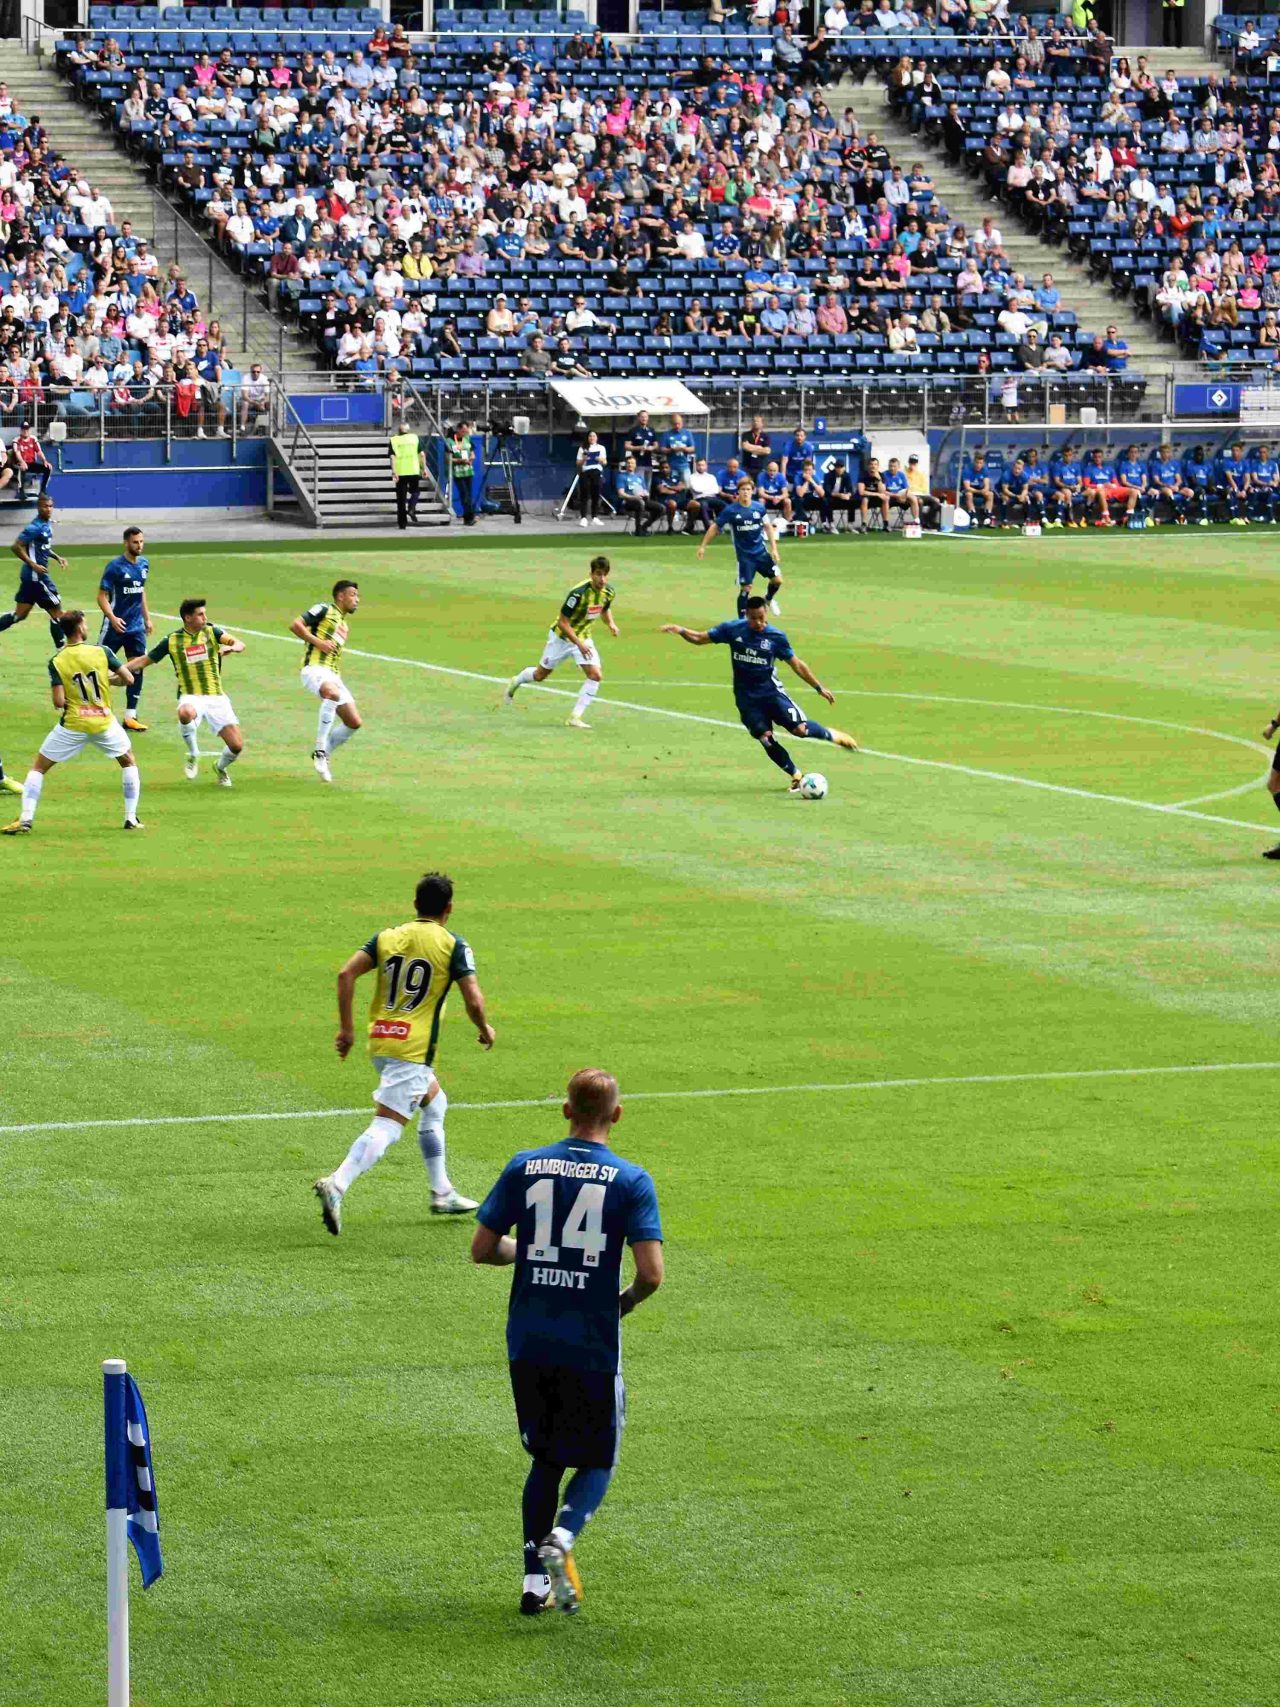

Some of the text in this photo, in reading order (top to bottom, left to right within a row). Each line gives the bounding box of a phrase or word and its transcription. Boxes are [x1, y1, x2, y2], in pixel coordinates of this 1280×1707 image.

[584, 393, 680, 409] NDR 2
[733, 651, 768, 665] Emirates
[72, 670, 102, 704] 11
[384, 955, 433, 1012] 19
[525, 1159, 619, 1182] HAMBURGER SV
[525, 1178, 608, 1268] 14
[531, 1267, 590, 1290] HUNT
